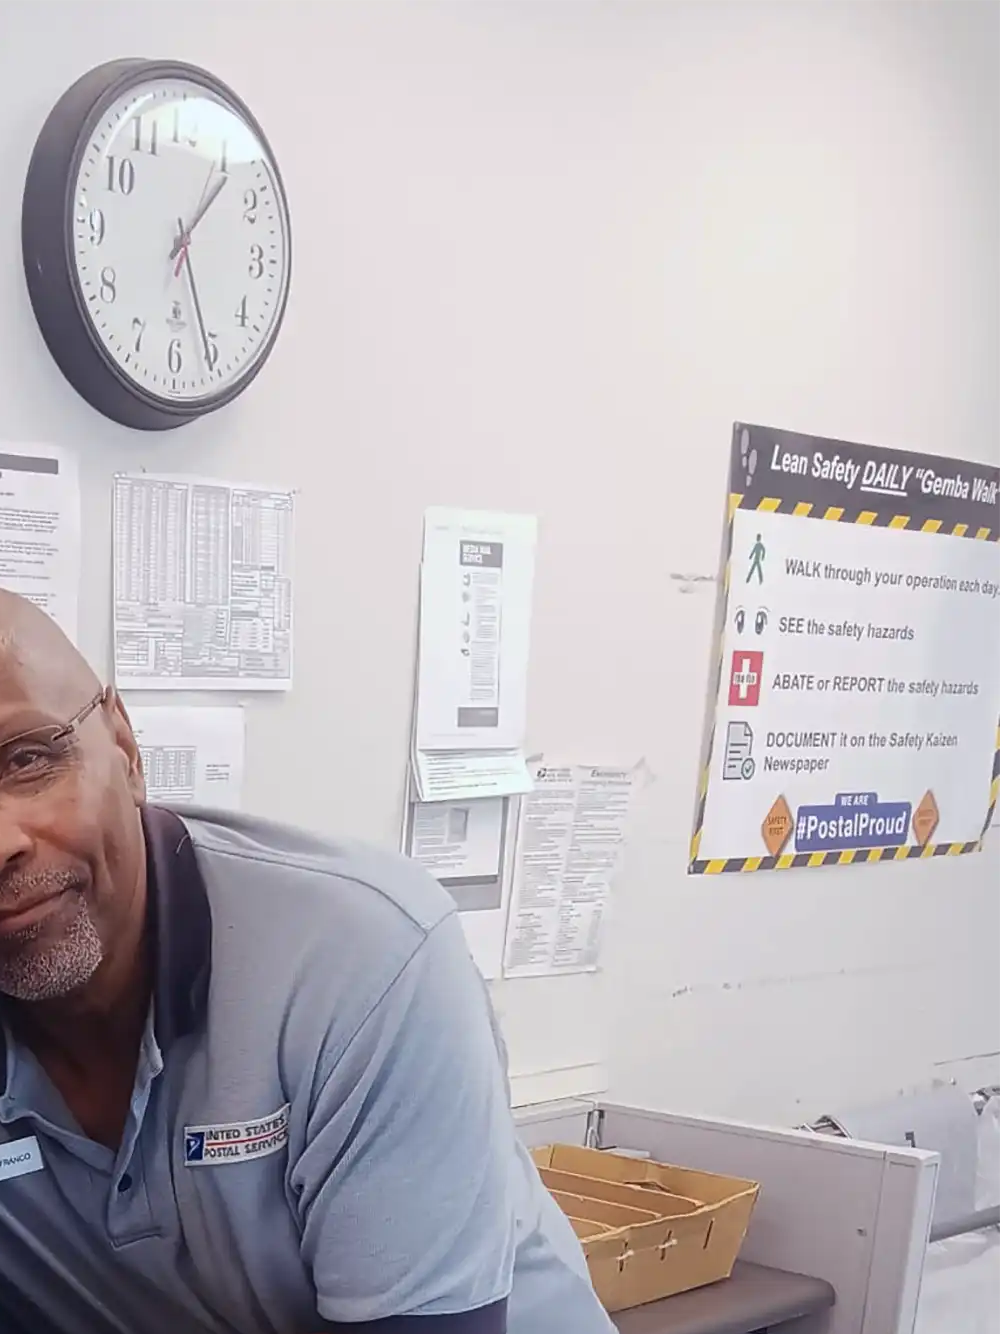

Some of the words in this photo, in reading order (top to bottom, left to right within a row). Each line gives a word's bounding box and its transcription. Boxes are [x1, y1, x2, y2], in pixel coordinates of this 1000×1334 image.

[104, 155, 135, 196] 10
[243, 189, 258, 224] 2
[89, 209, 105, 246] 9
[248, 244, 264, 279] 3
[100, 266, 117, 303] 8
[234, 295, 250, 329] 4
[131, 318, 147, 352] 7
[168, 339, 182, 374] 6
[771, 444, 808, 476] Lean
[811, 452, 861, 489] Safety
[861, 460, 913, 491] DAILY
[785, 558, 821, 578] WALK
[824, 563, 871, 586] through
[873, 571, 903, 587] your
[905, 574, 957, 590] operation
[959, 579, 979, 592] each
[778, 616, 804, 633] SEE
[807, 618, 825, 634] the
[827, 620, 864, 641] safety
[867, 622, 914, 640] hazards
[771, 673, 814, 690] ABATE
[816, 679, 830, 690] or
[832, 675, 885, 692] REPORT
[887, 678, 905, 693] the
[908, 679, 939, 697] safety
[941, 680, 978, 694] hazards
[766, 731, 837, 748] DOCUMENT
[839, 732, 847, 747] it
[850, 735, 865, 747] on
[868, 732, 886, 747] the
[888, 732, 924, 750] Safety
[925, 732, 957, 746] Kaizen
[763, 755, 829, 774] Newspaper
[797, 811, 907, 840] #PostalProud
[0, 1152, 31, 1167] FRANCO
[204, 1146, 240, 1158] POSTAL
[244, 1129, 289, 1153] SERVIC
